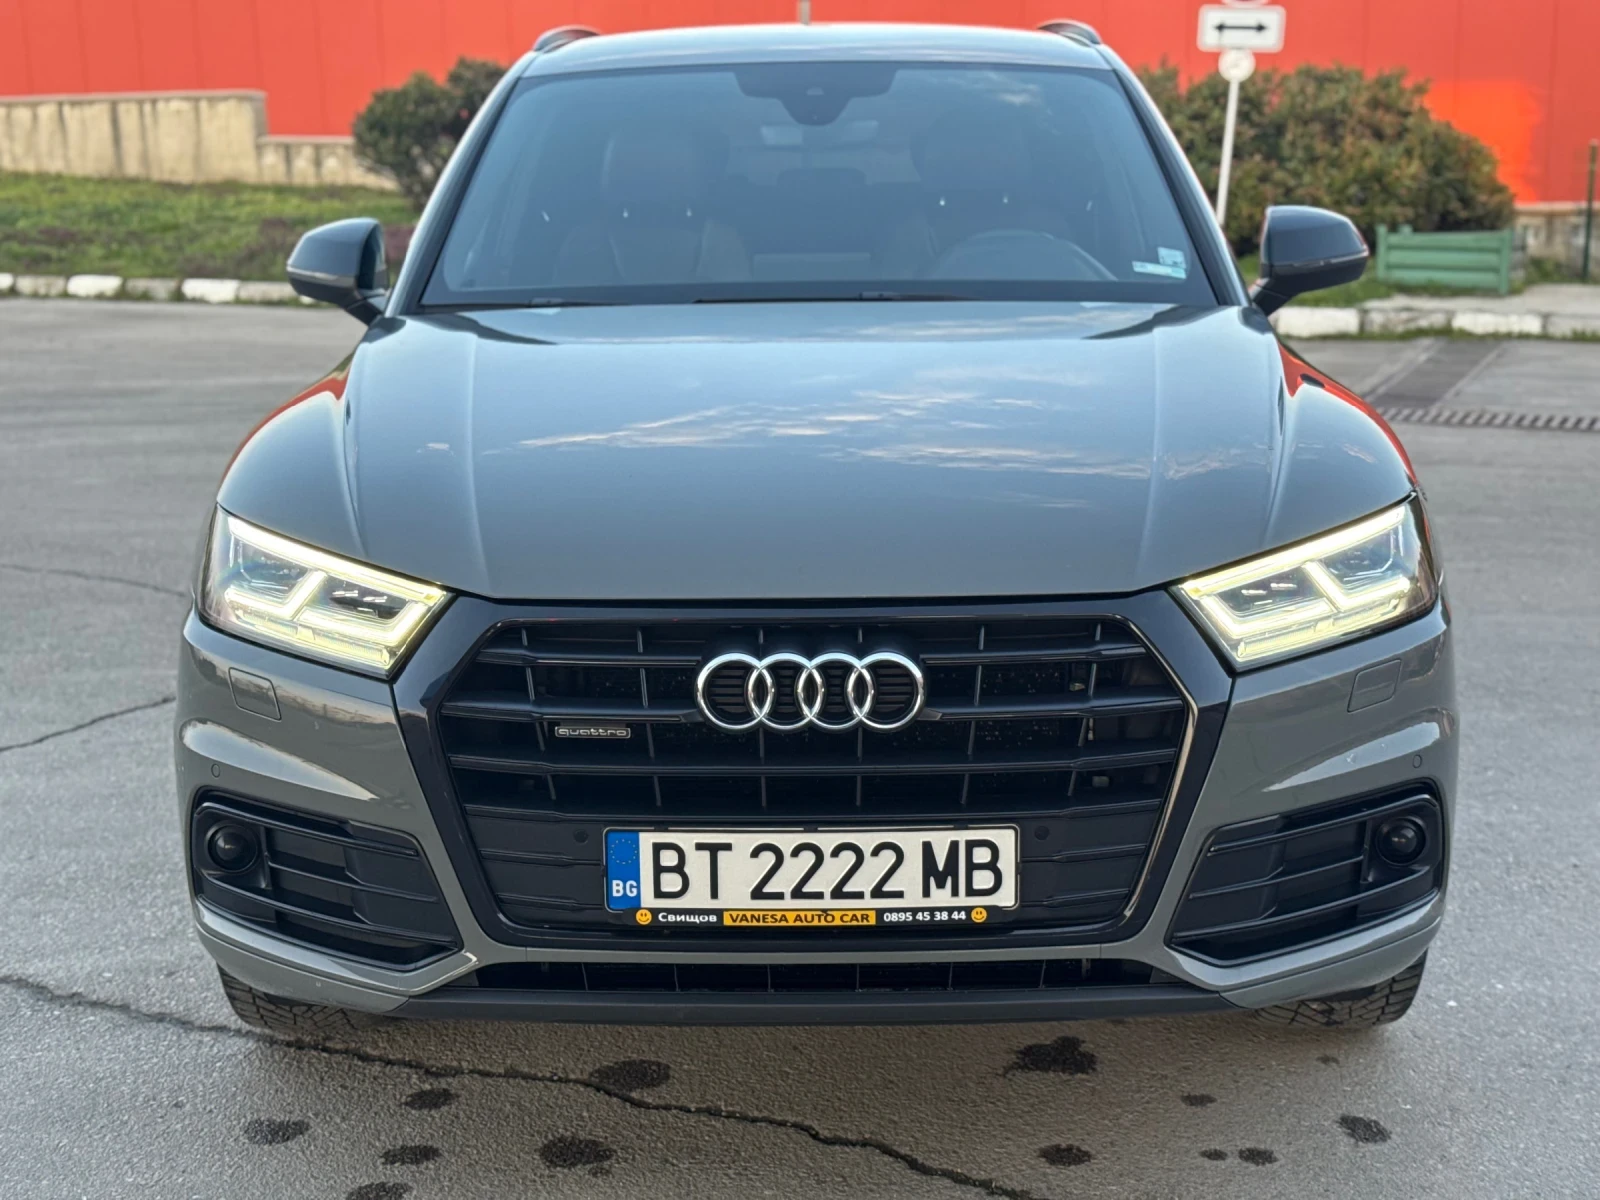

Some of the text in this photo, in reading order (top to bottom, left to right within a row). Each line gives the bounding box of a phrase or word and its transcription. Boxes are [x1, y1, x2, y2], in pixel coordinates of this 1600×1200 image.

[558, 728, 627, 736] quattro
[652, 839, 1003, 900] BT 2222 MB
[611, 879, 638, 898] BG
[658, 912, 717, 924] Свищов
[729, 911, 870, 924] VANESA AUTO CAR
[883, 910, 967, 922] 0895 45 38 44
